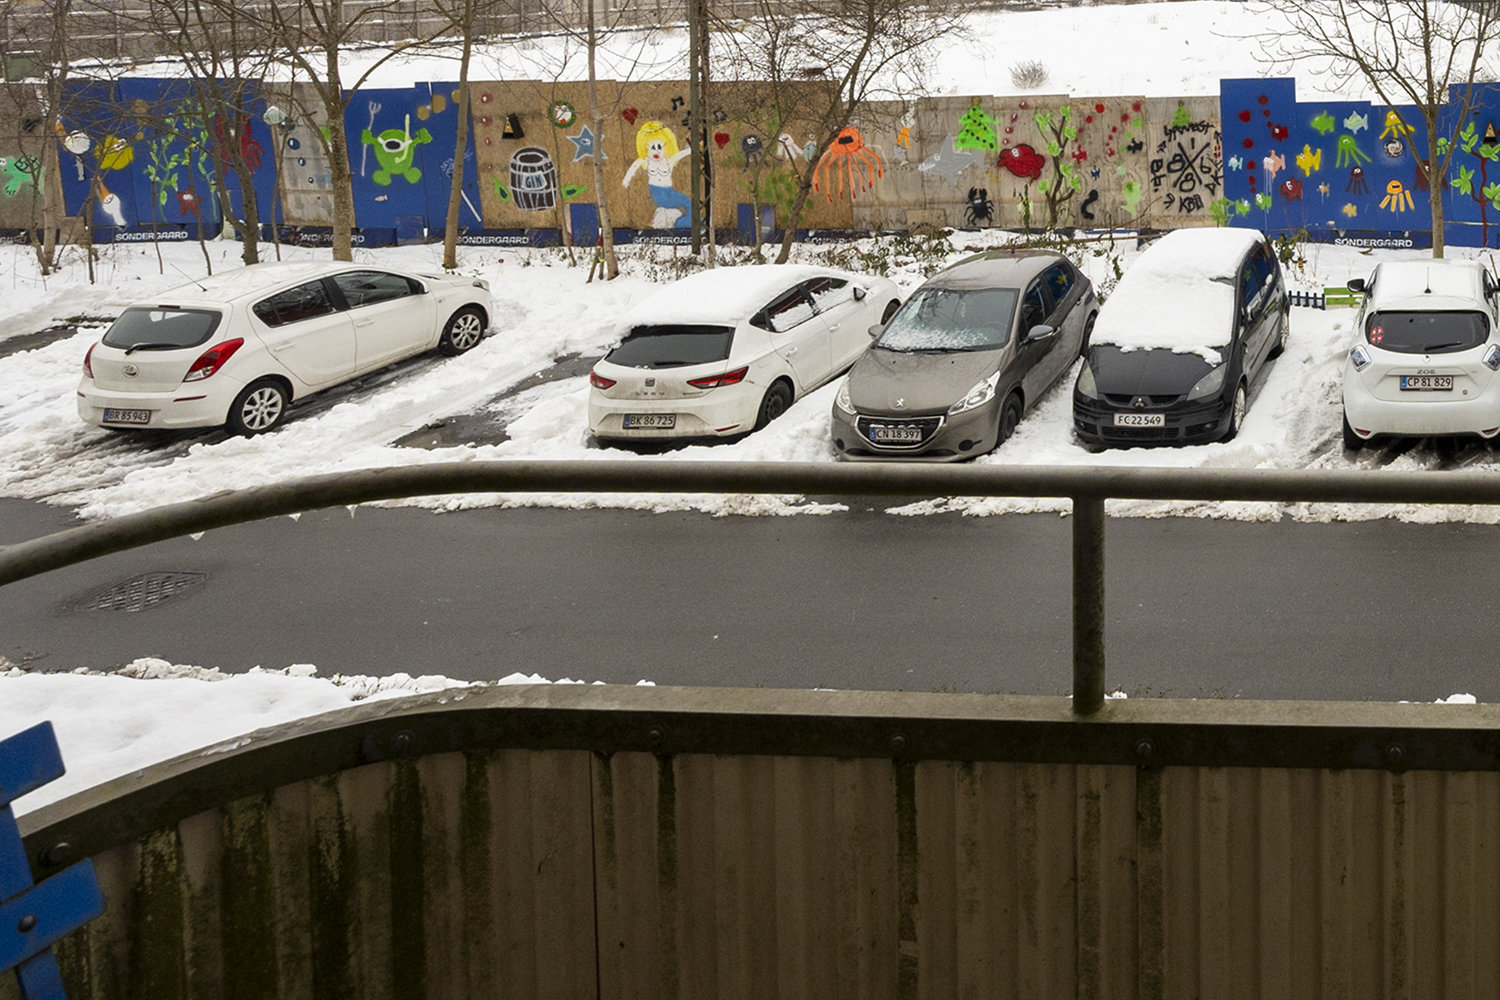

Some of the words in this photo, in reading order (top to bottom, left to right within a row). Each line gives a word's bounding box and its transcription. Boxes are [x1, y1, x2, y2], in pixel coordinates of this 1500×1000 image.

[525, 176, 543, 188] GIN
[1407, 377, 1420, 387] CP
[1421, 377, 1432, 387] 81
[1434, 377, 1451, 387] 829
[630, 415, 642, 425] BK
[643, 415, 655, 425] 86
[657, 415, 674, 425] 725
[1131, 415, 1142, 425] 22
[876, 428, 889, 439] CN
[891, 429, 902, 439] 18
[903, 430, 920, 439] 397
